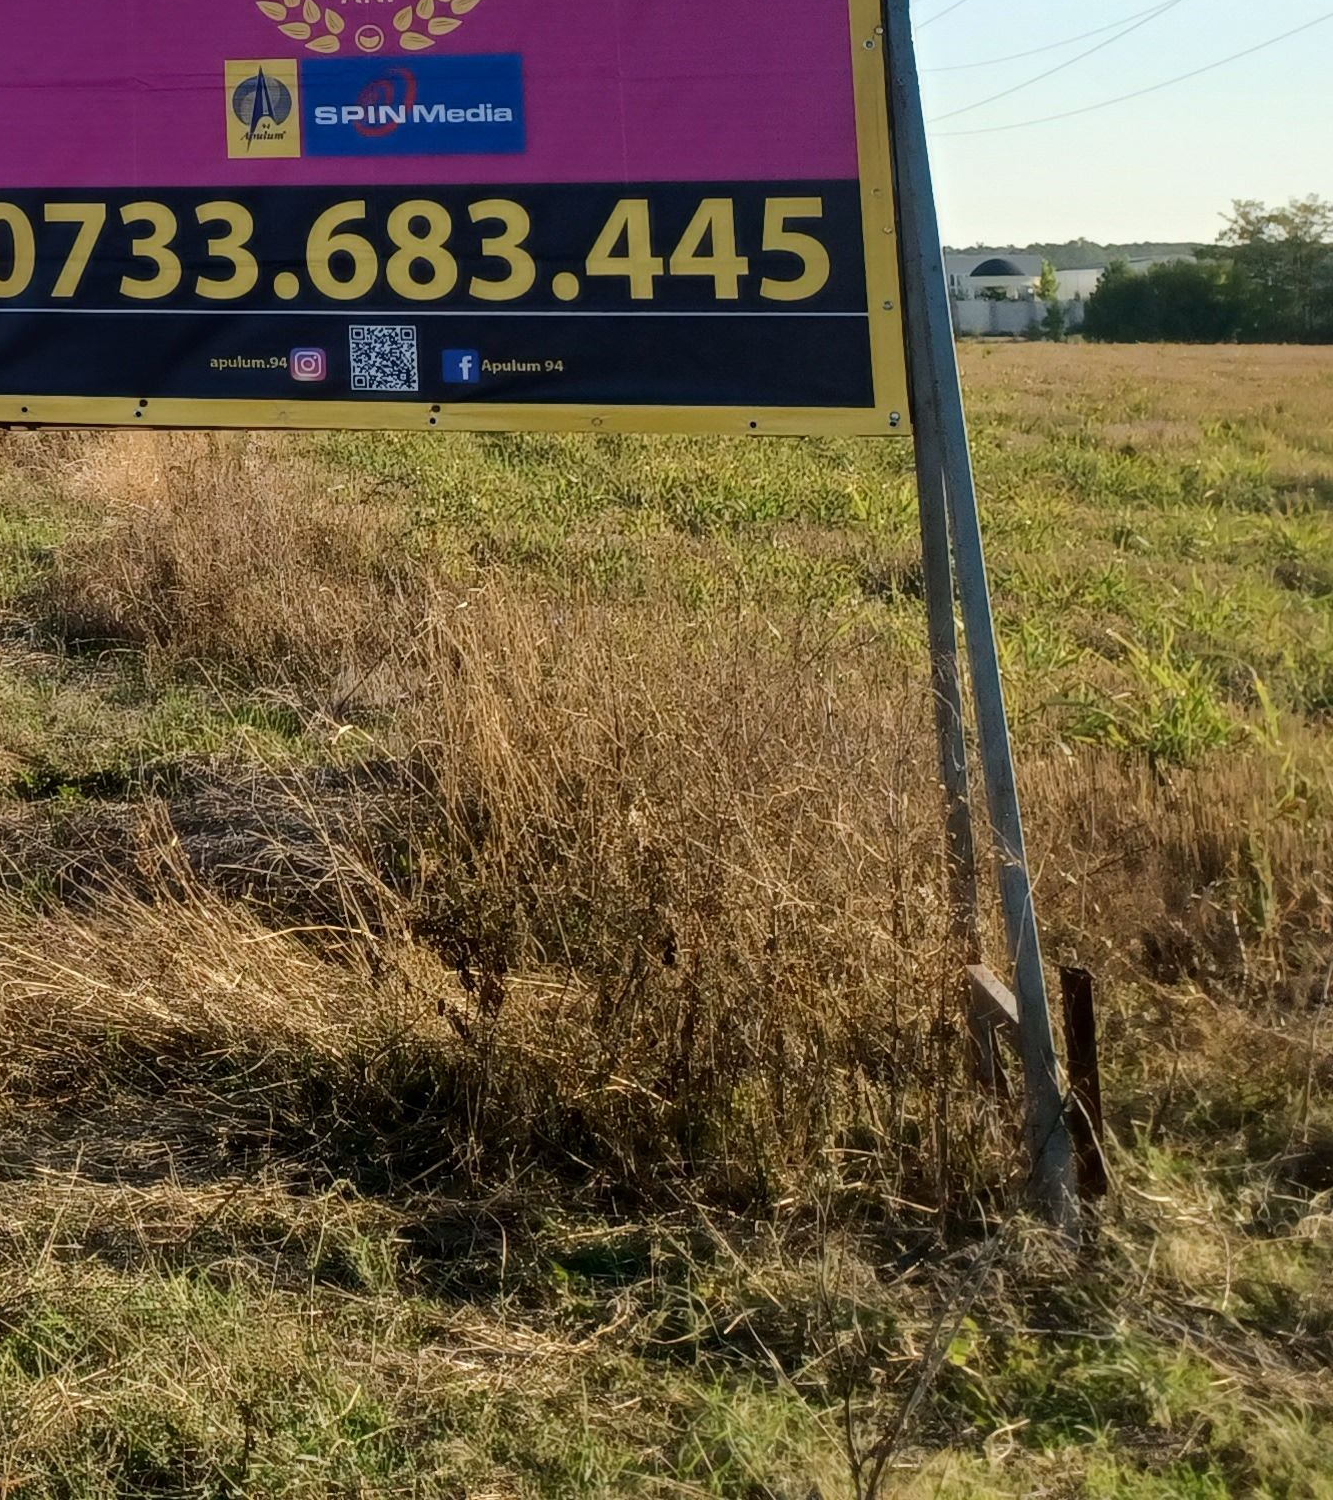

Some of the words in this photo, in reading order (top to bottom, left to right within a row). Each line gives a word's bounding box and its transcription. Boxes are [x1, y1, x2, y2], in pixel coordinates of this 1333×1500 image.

[209, 355, 288, 370] apulum.94
[481, 360, 541, 374] Apulum
[544, 359, 564, 373] 94
